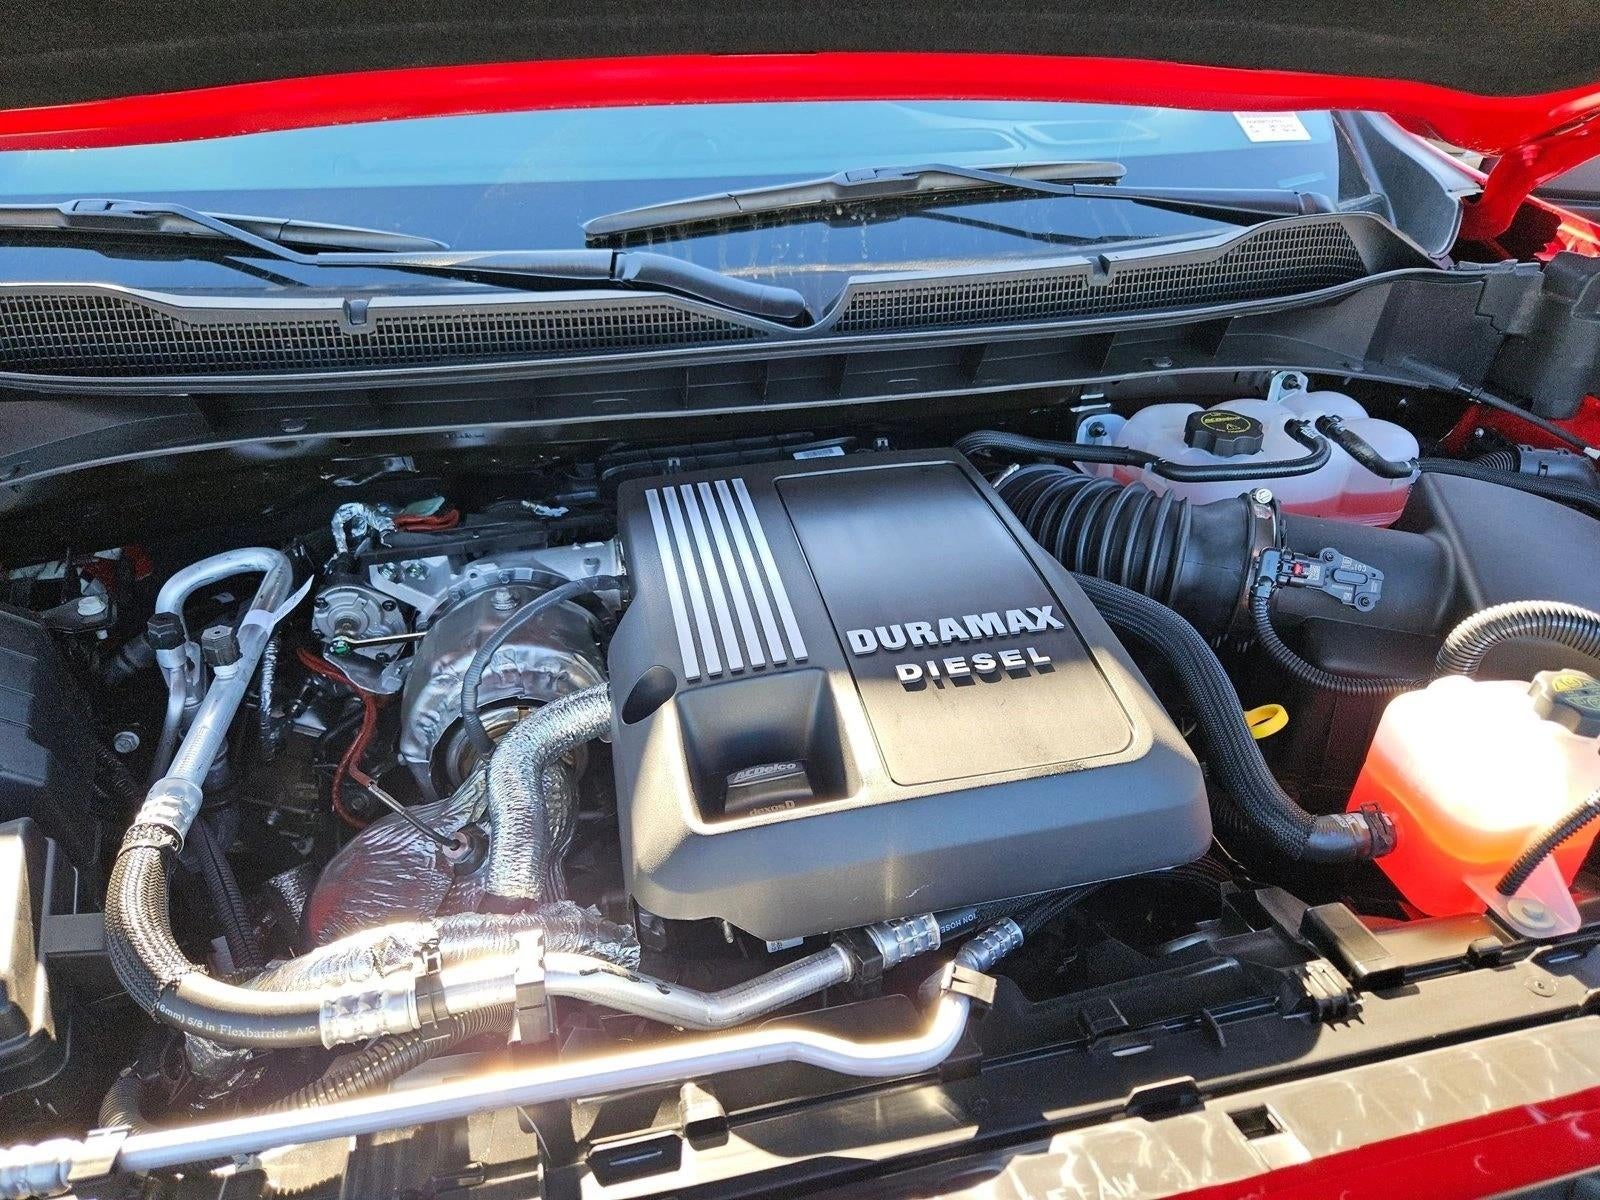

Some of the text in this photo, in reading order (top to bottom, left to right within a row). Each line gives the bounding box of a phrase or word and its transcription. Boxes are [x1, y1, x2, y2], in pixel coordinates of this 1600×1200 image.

[846, 605, 1065, 656] DURAMAX
[895, 647, 1051, 684] DIESEL
[940, 912, 978, 934] ION HOSE
[187, 1017, 203, 1029] 5/8
[205, 1021, 215, 1032] in
[219, 1024, 289, 1039] Flexbarrier
[296, 1025, 317, 1037] A/C
